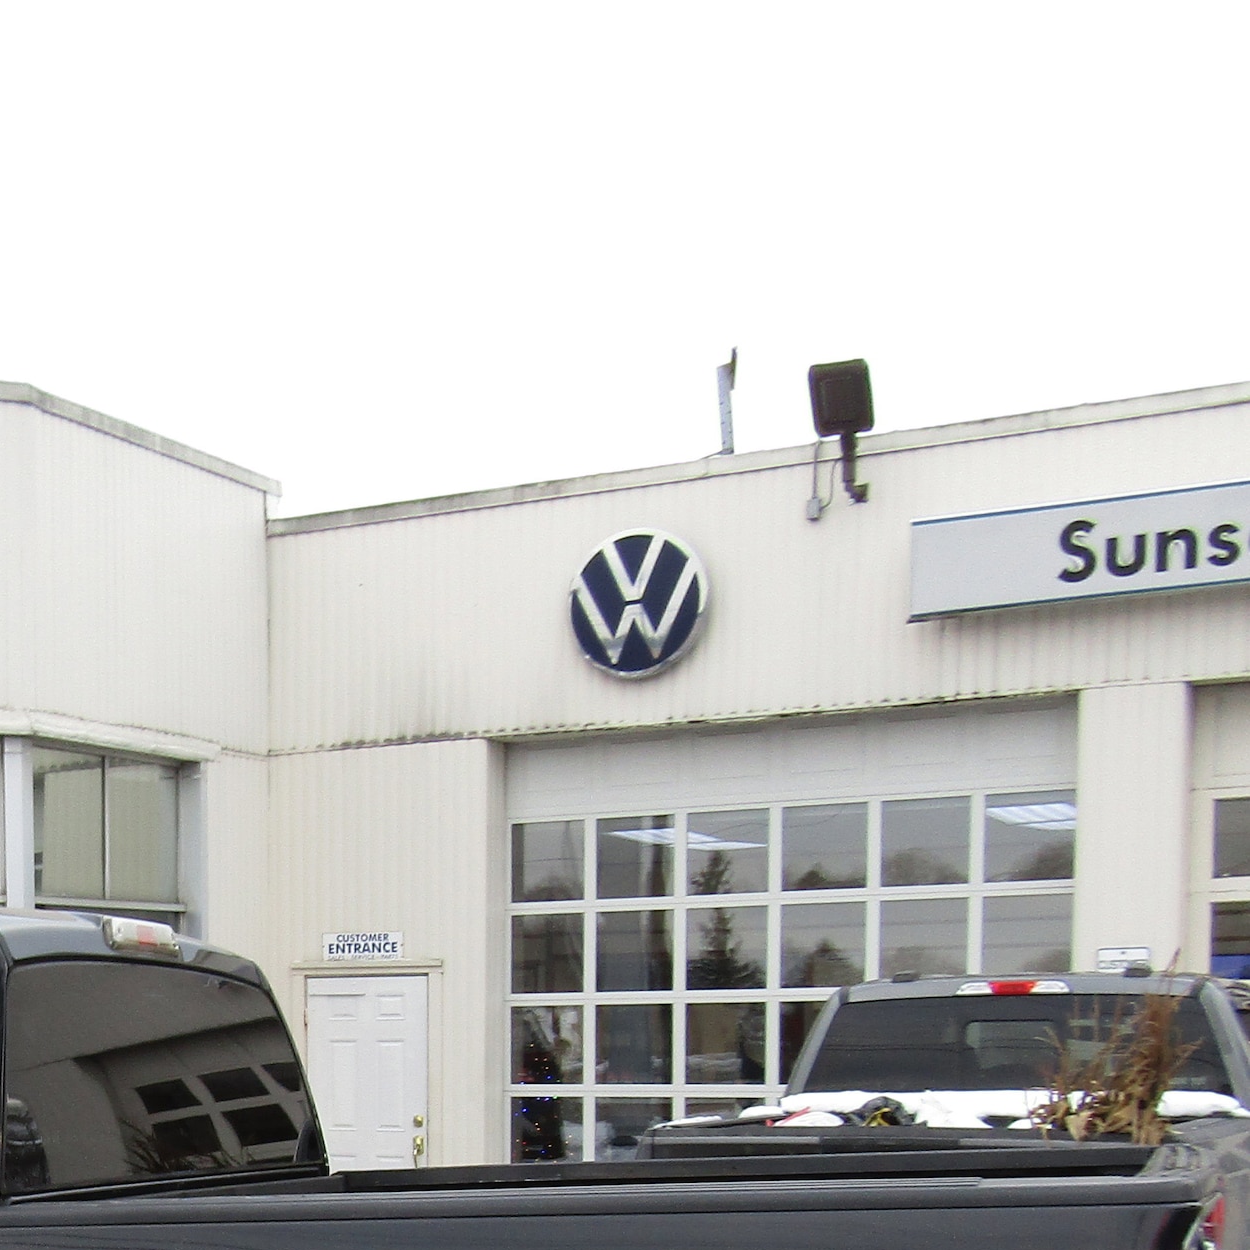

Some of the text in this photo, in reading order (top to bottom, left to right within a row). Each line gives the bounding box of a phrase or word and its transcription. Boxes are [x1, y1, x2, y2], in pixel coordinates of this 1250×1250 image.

[1057, 518, 1250, 584] Suns
[572, 530, 706, 676] VW
[328, 942, 399, 954] ENTRANCE
[336, 933, 390, 943] CUSTOMER
